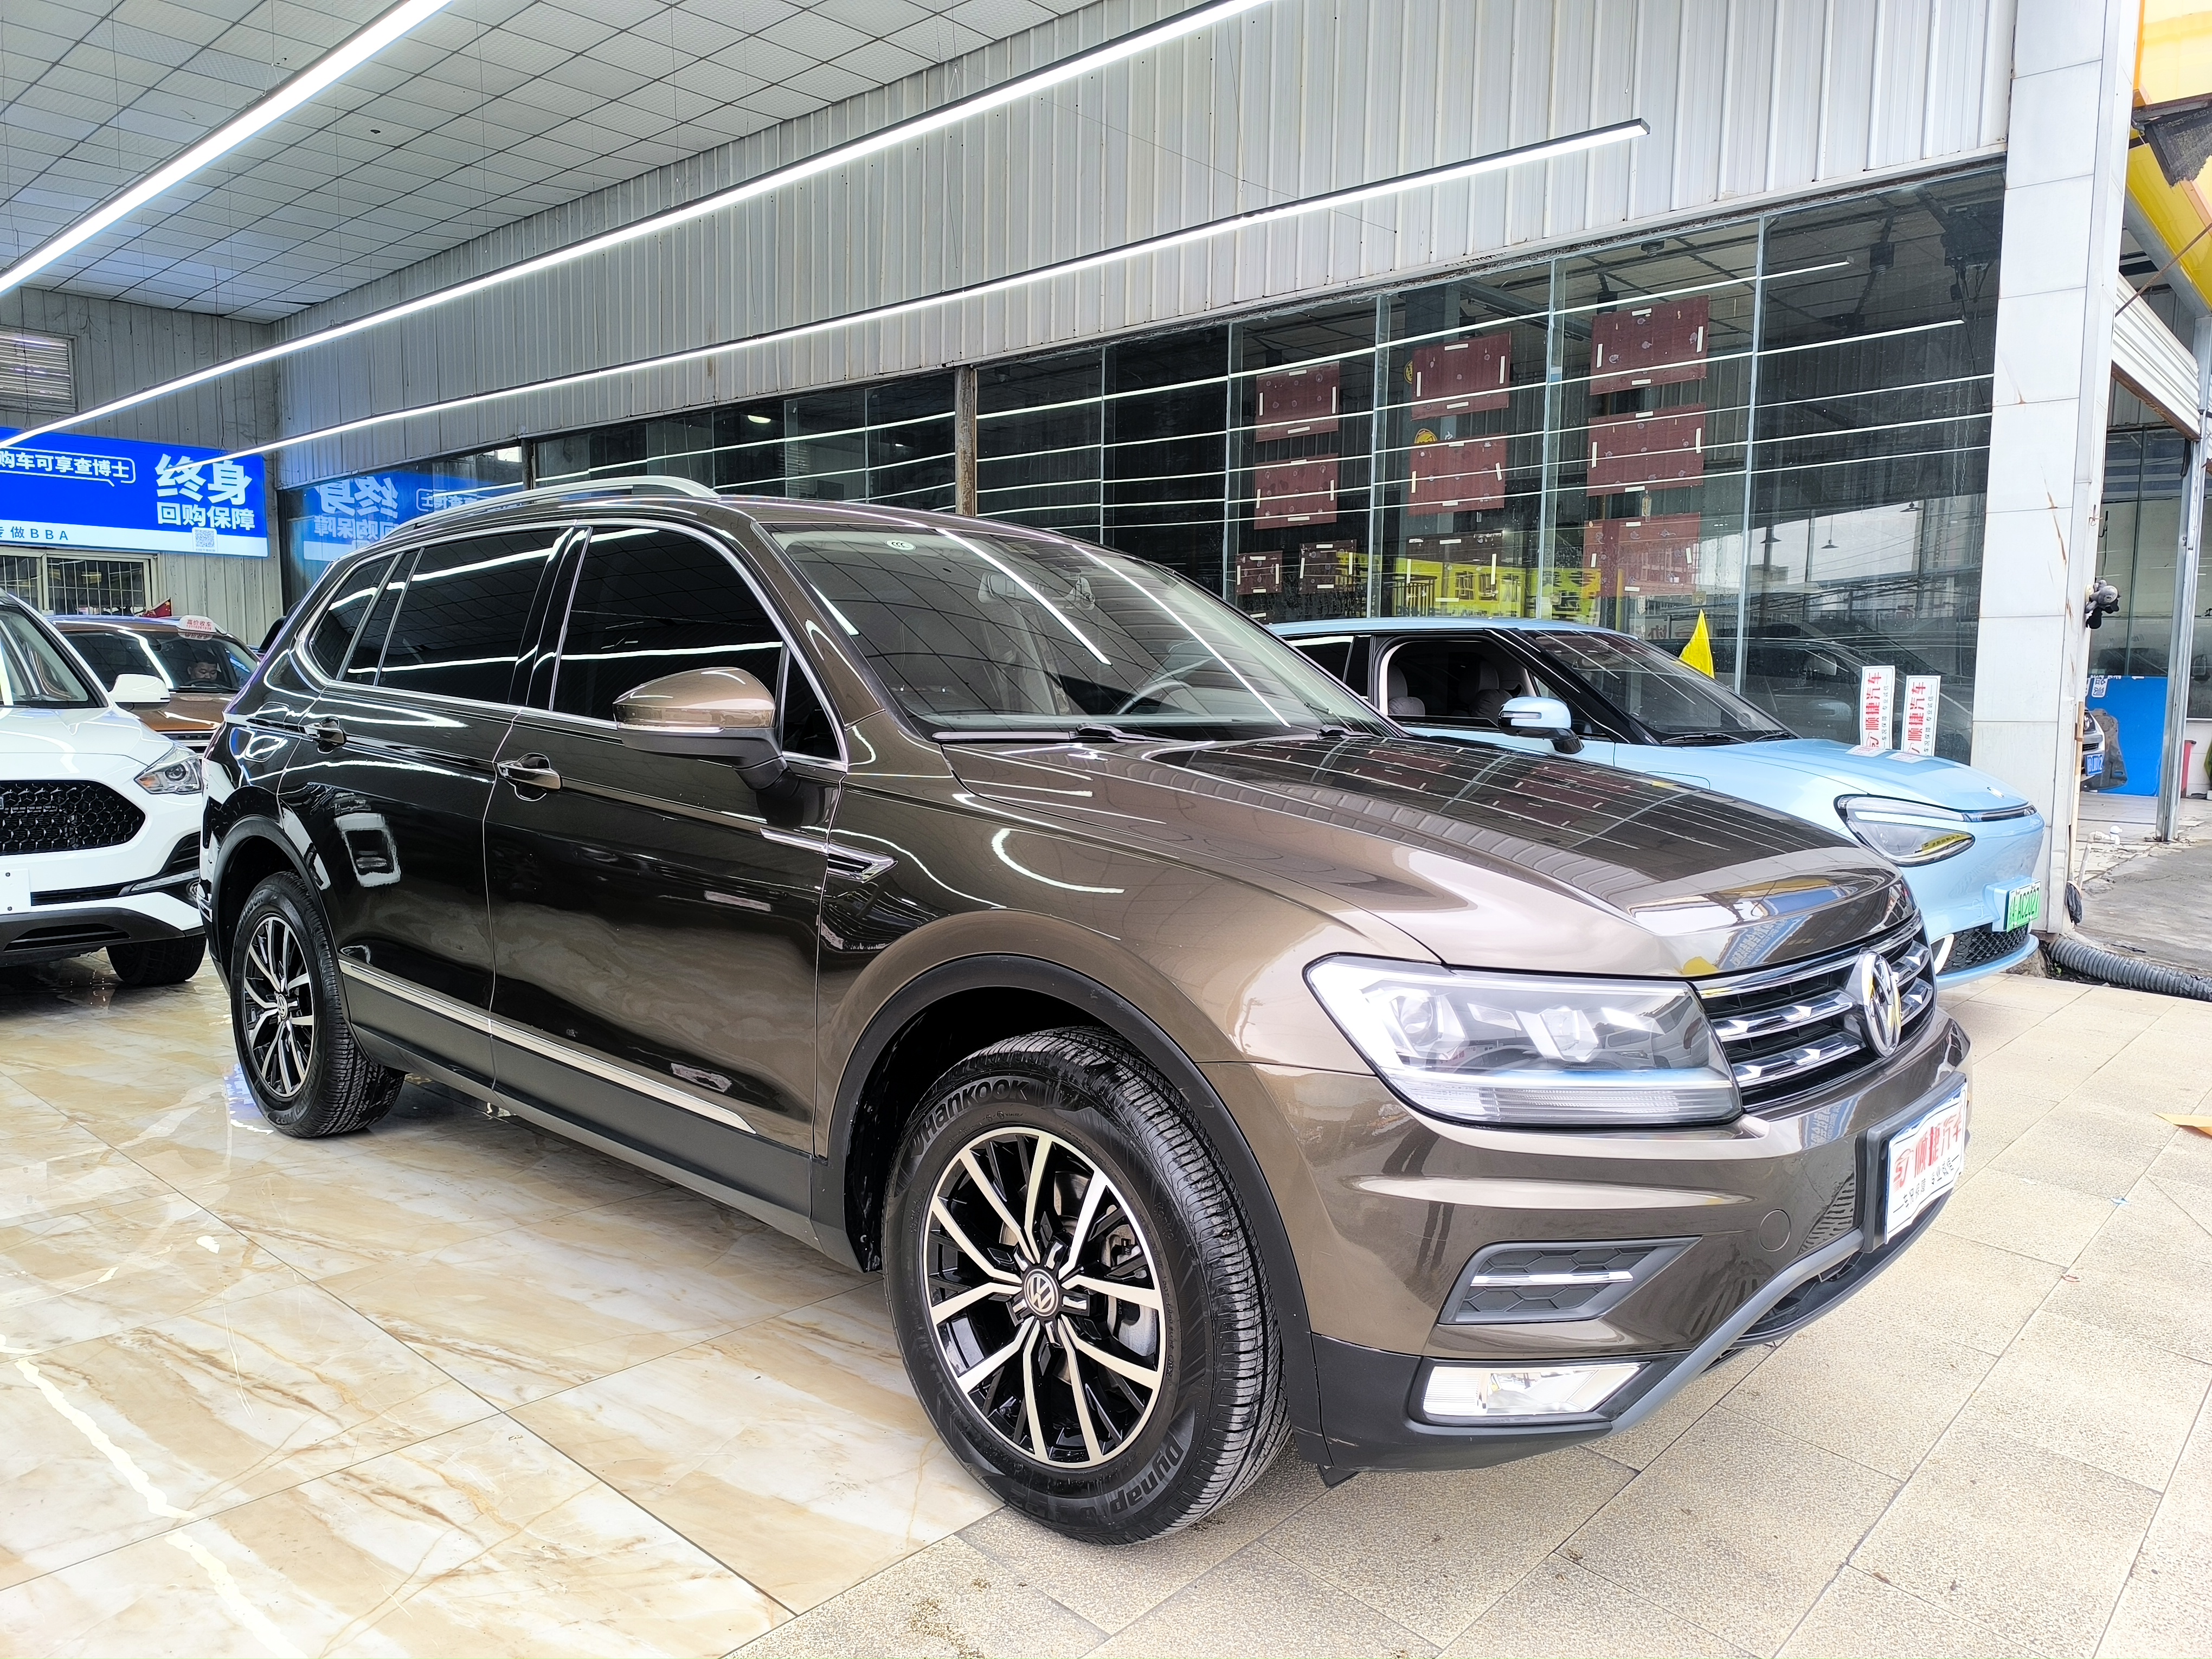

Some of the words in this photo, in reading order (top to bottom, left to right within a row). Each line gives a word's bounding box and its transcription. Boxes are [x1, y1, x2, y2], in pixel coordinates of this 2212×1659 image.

[0, 451, 130, 478] 购车可享查博士
[155, 453, 252, 505] 终身
[157, 502, 255, 531] 回购保障
[1866, 672, 1882, 730] 顺捷汽车
[1907, 681, 1926, 742] 顺捷汽车
